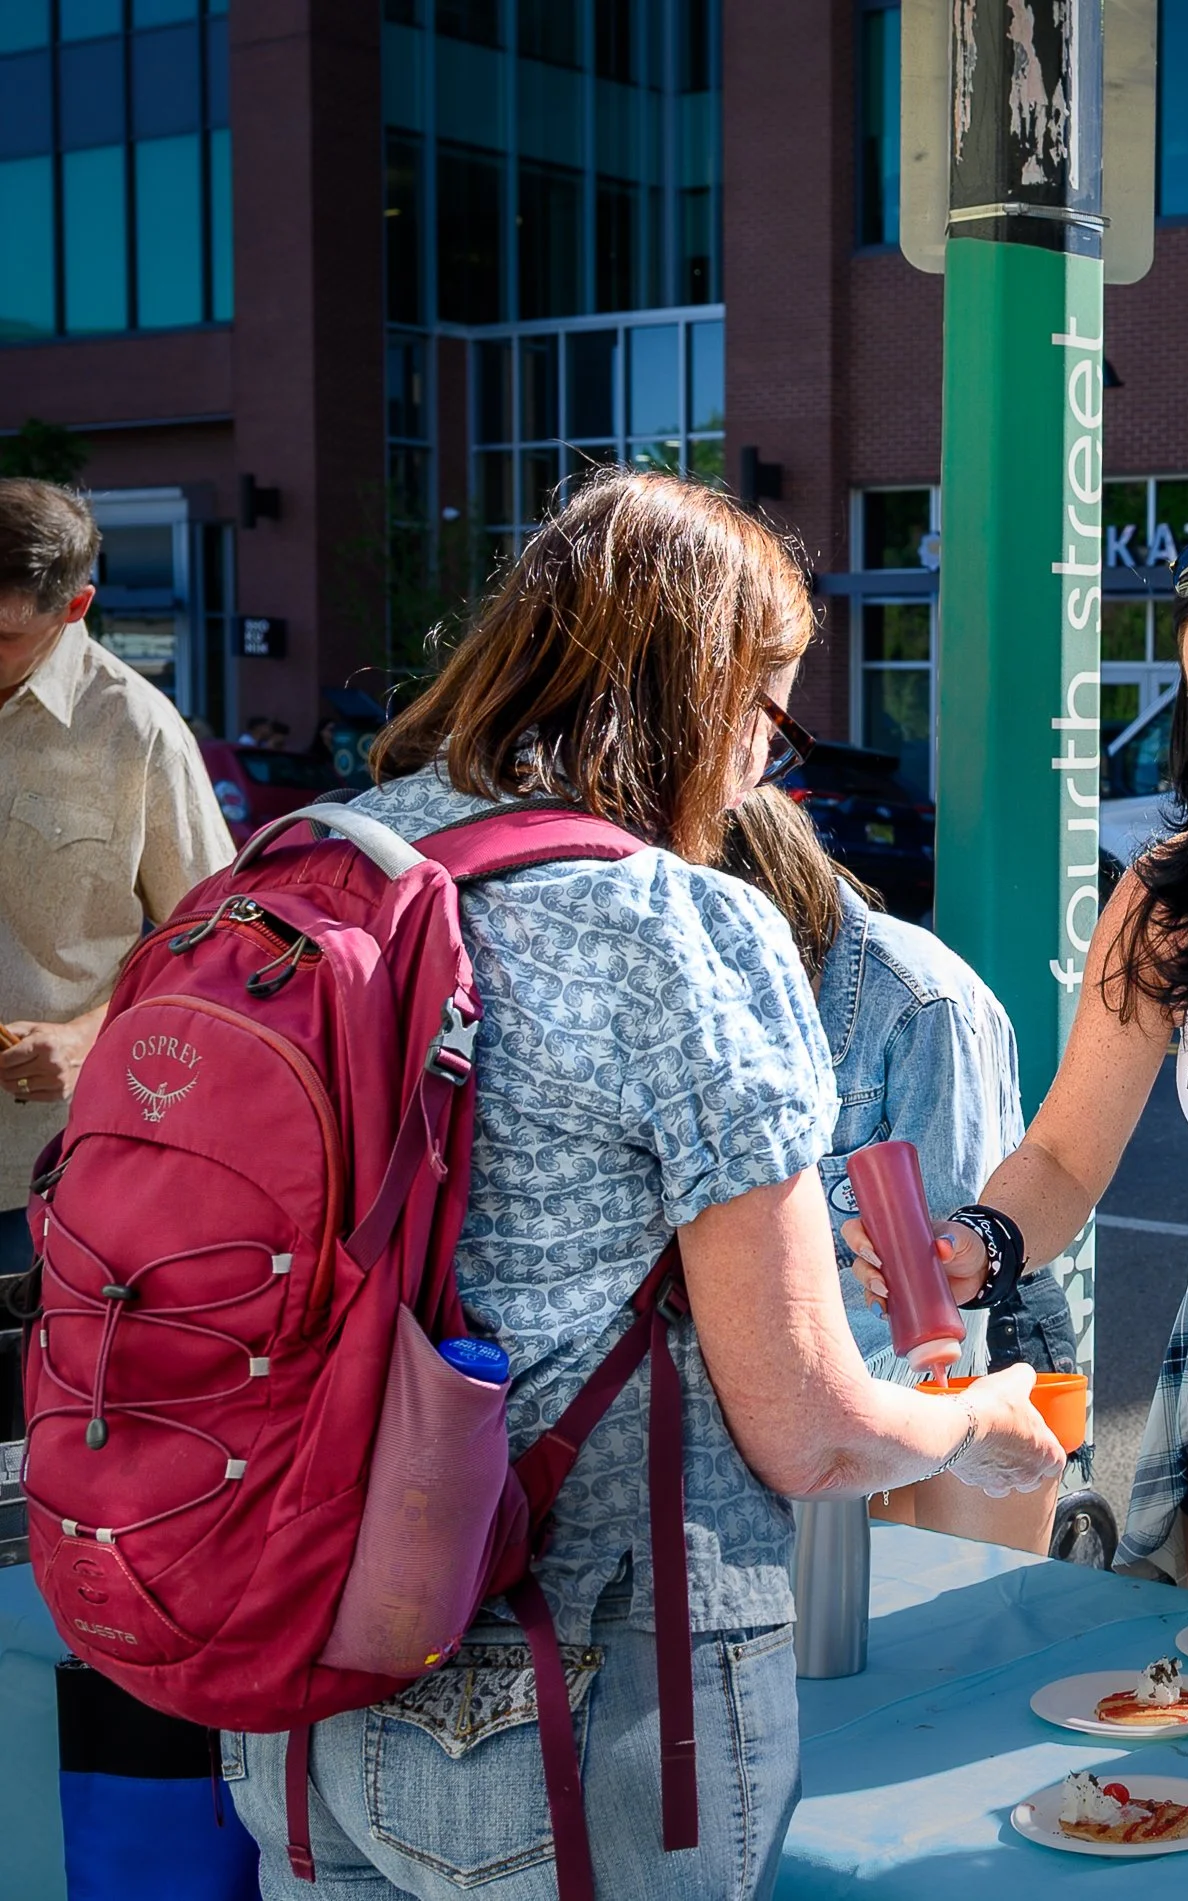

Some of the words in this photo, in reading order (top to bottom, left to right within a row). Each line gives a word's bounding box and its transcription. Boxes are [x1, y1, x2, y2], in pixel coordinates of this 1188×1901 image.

[1052, 317, 1102, 633] street
[1050, 671, 1100, 993] fourth
[132, 1035, 203, 1070] OSPREY
